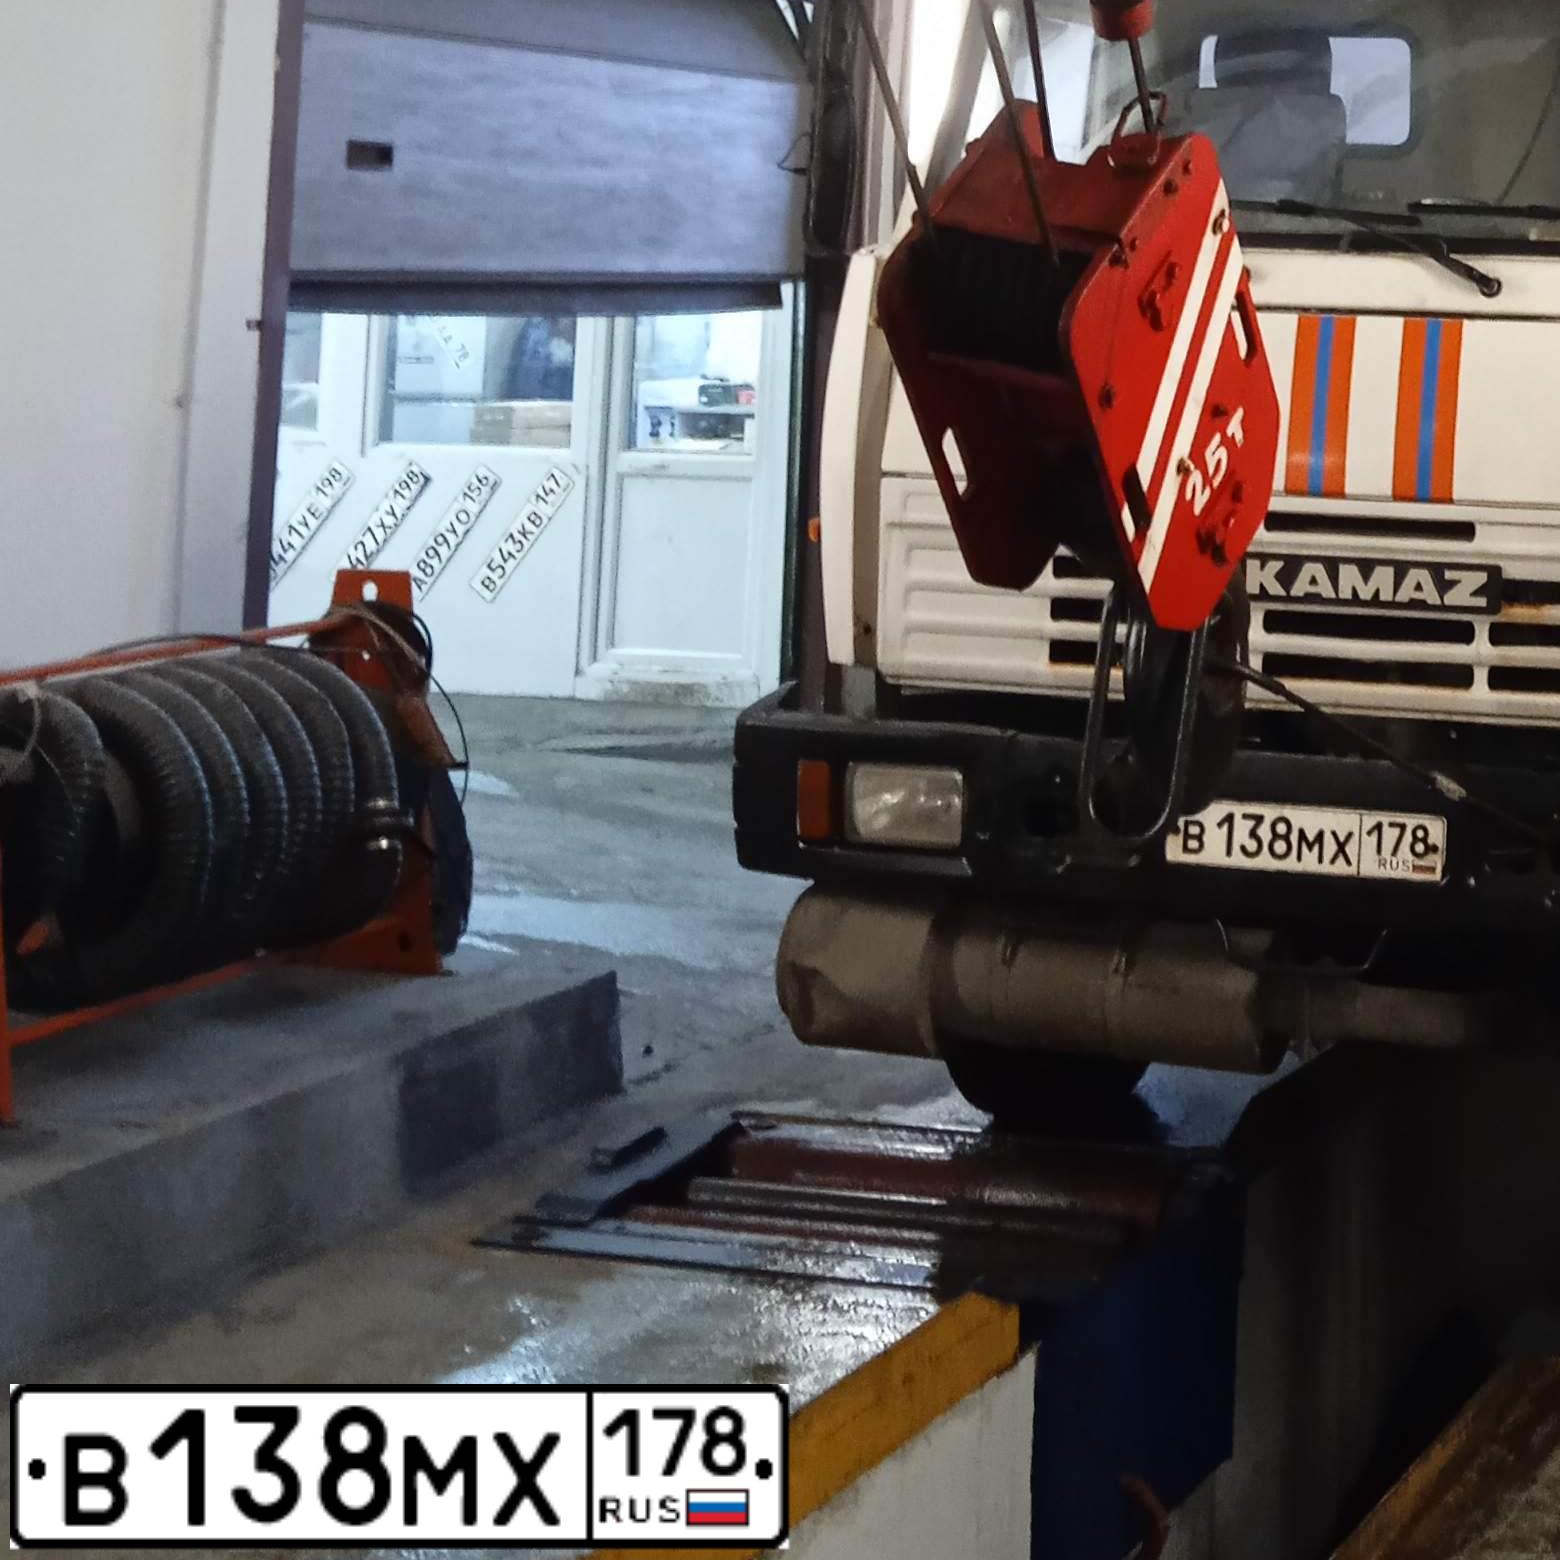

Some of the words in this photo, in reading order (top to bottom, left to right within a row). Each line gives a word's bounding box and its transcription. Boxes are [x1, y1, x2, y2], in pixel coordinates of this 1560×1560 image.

[462, 473, 489, 503] 156
[535, 473, 562, 505] 147
[269, 502, 323, 582] 441УЕ
[315, 468, 343, 497] 198
[346, 504, 400, 568] 427ХУ
[393, 469, 421, 500] 198
[1245, 558, 1488, 608] KAMAZ
[1366, 821, 1430, 859] 178
[1378, 857, 1411, 872] RUS
